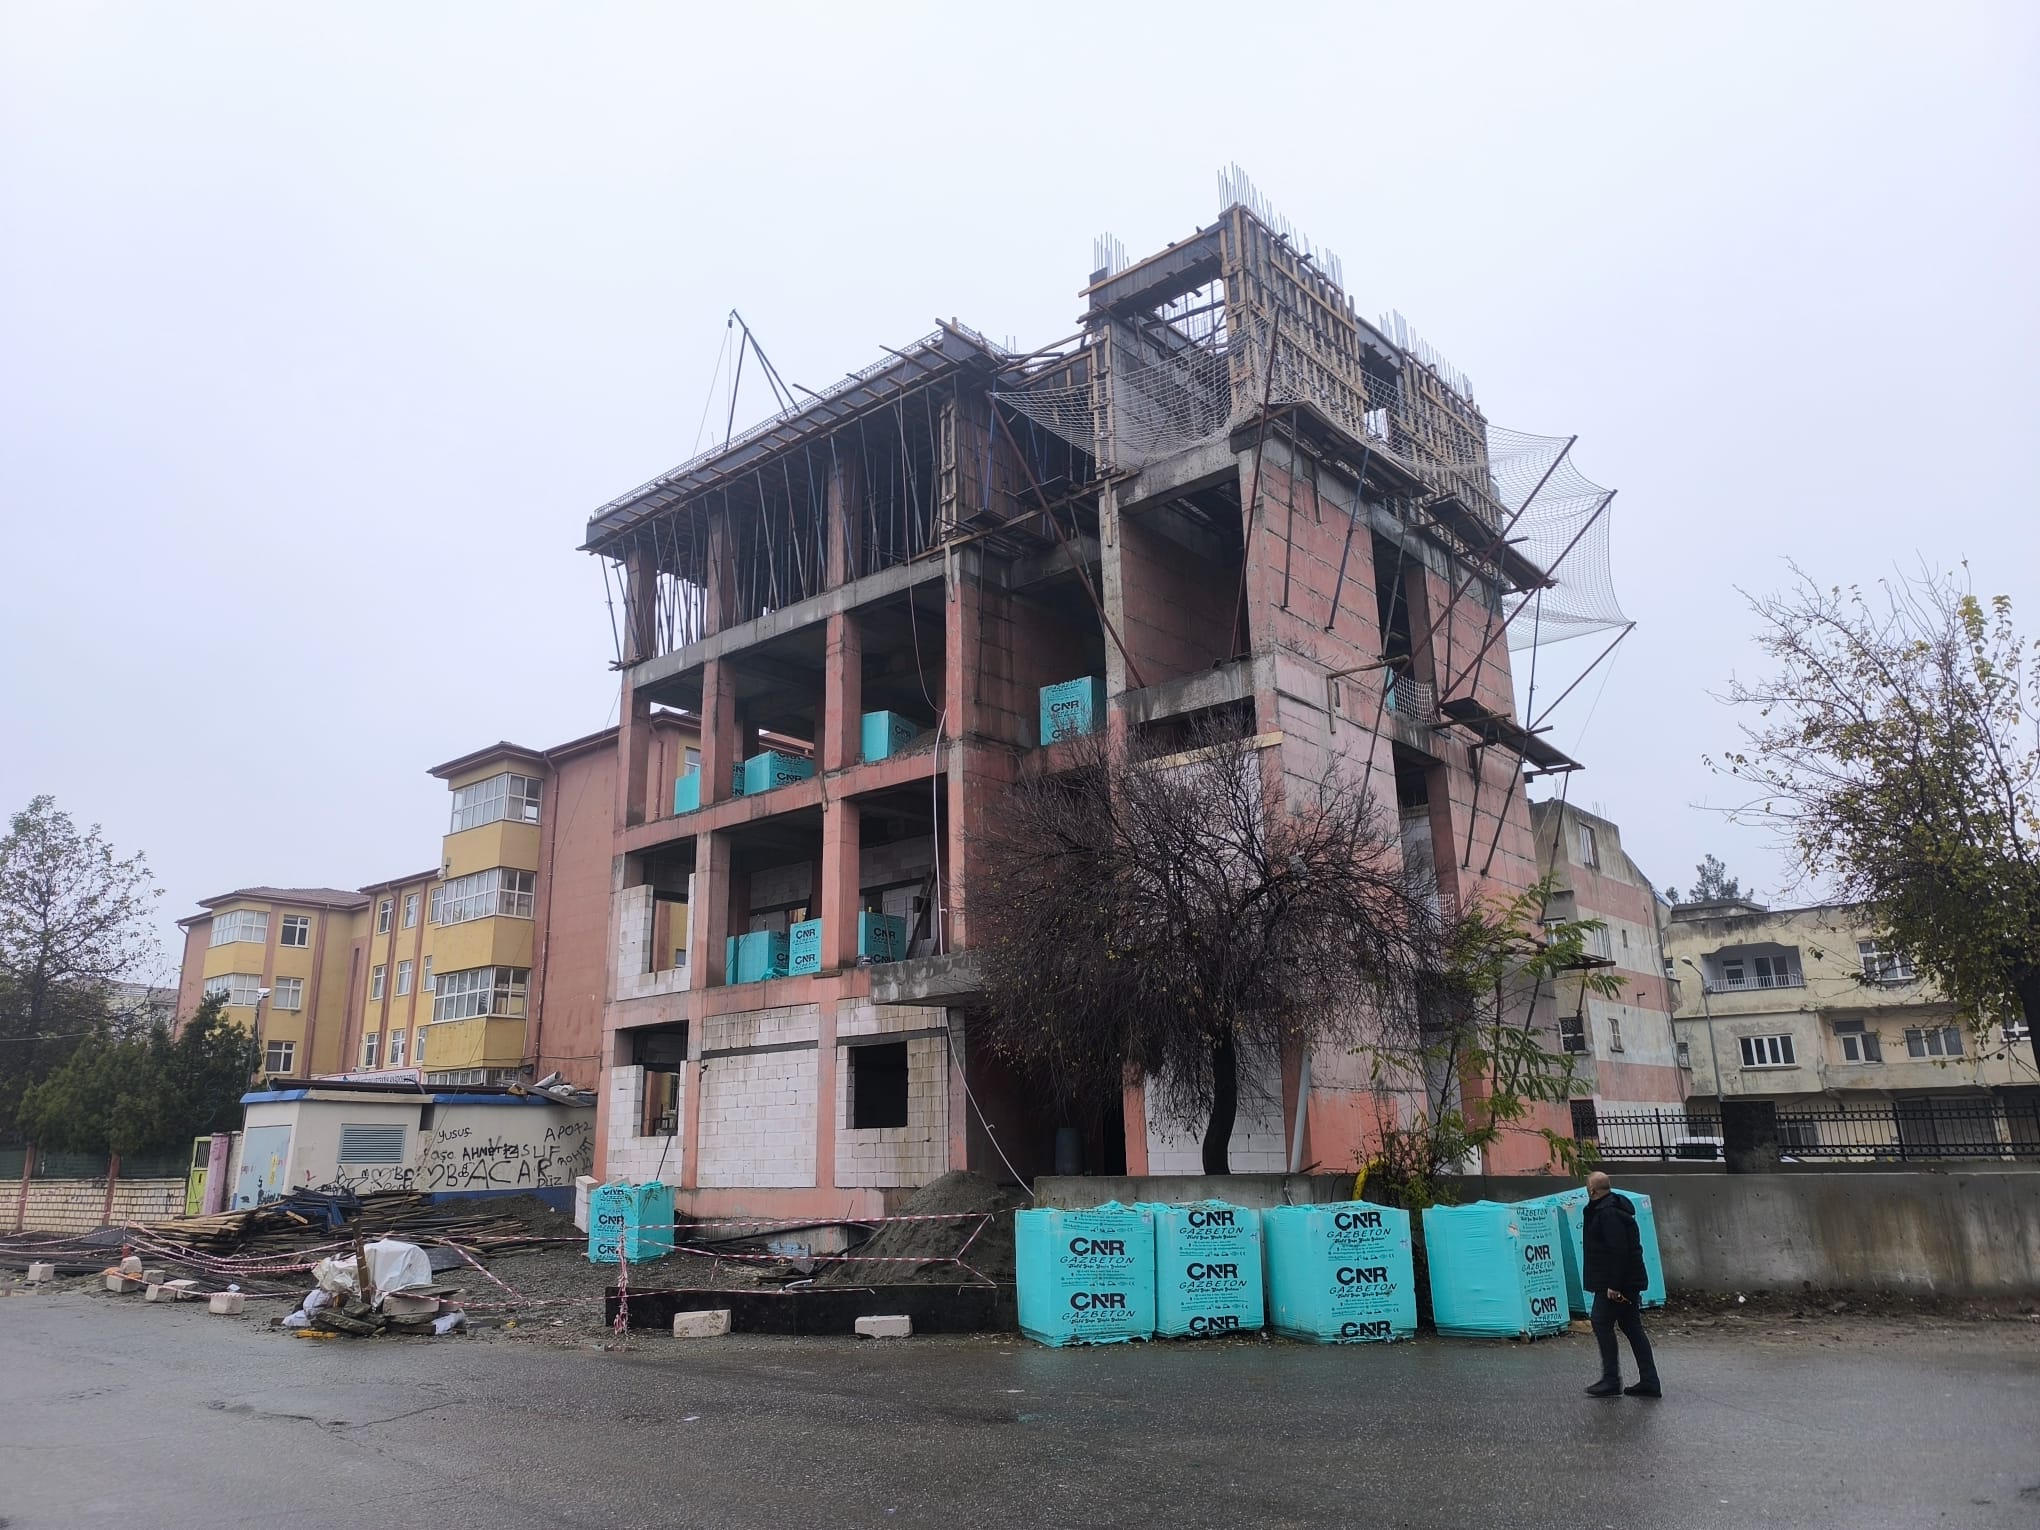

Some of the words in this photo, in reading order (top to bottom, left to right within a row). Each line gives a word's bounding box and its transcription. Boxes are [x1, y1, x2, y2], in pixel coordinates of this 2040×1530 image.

[1051, 700, 1079, 712] CNR
[796, 928, 816, 940] CNR
[794, 953, 816, 965] CNR
[598, 1214, 625, 1225] CNR
[1188, 1210, 1236, 1228] CNR
[1334, 1211, 1383, 1232] CNR
[1179, 1226, 1245, 1236] GAZBETON
[1326, 1227, 1392, 1239] GAZBETON
[597, 1243, 619, 1254] CN
[1069, 1237, 1126, 1256] CNR
[1059, 1255, 1136, 1264] GAZBETON
[1524, 1244, 1552, 1264] CNR
[1186, 1262, 1239, 1281] CNR
[1521, 1260, 1556, 1273] GAZBETON
[1336, 1266, 1389, 1286] CNR
[1179, 1279, 1248, 1290] GAZBETON
[1329, 1282, 1398, 1295] GAZBETON
[1070, 1291, 1127, 1311] CNR
[1531, 1296, 1558, 1317] CNR
[1061, 1310, 1137, 1321] GAZBETON
[1188, 1315, 1240, 1332] CNR
[1340, 1320, 1393, 1338] CNR
